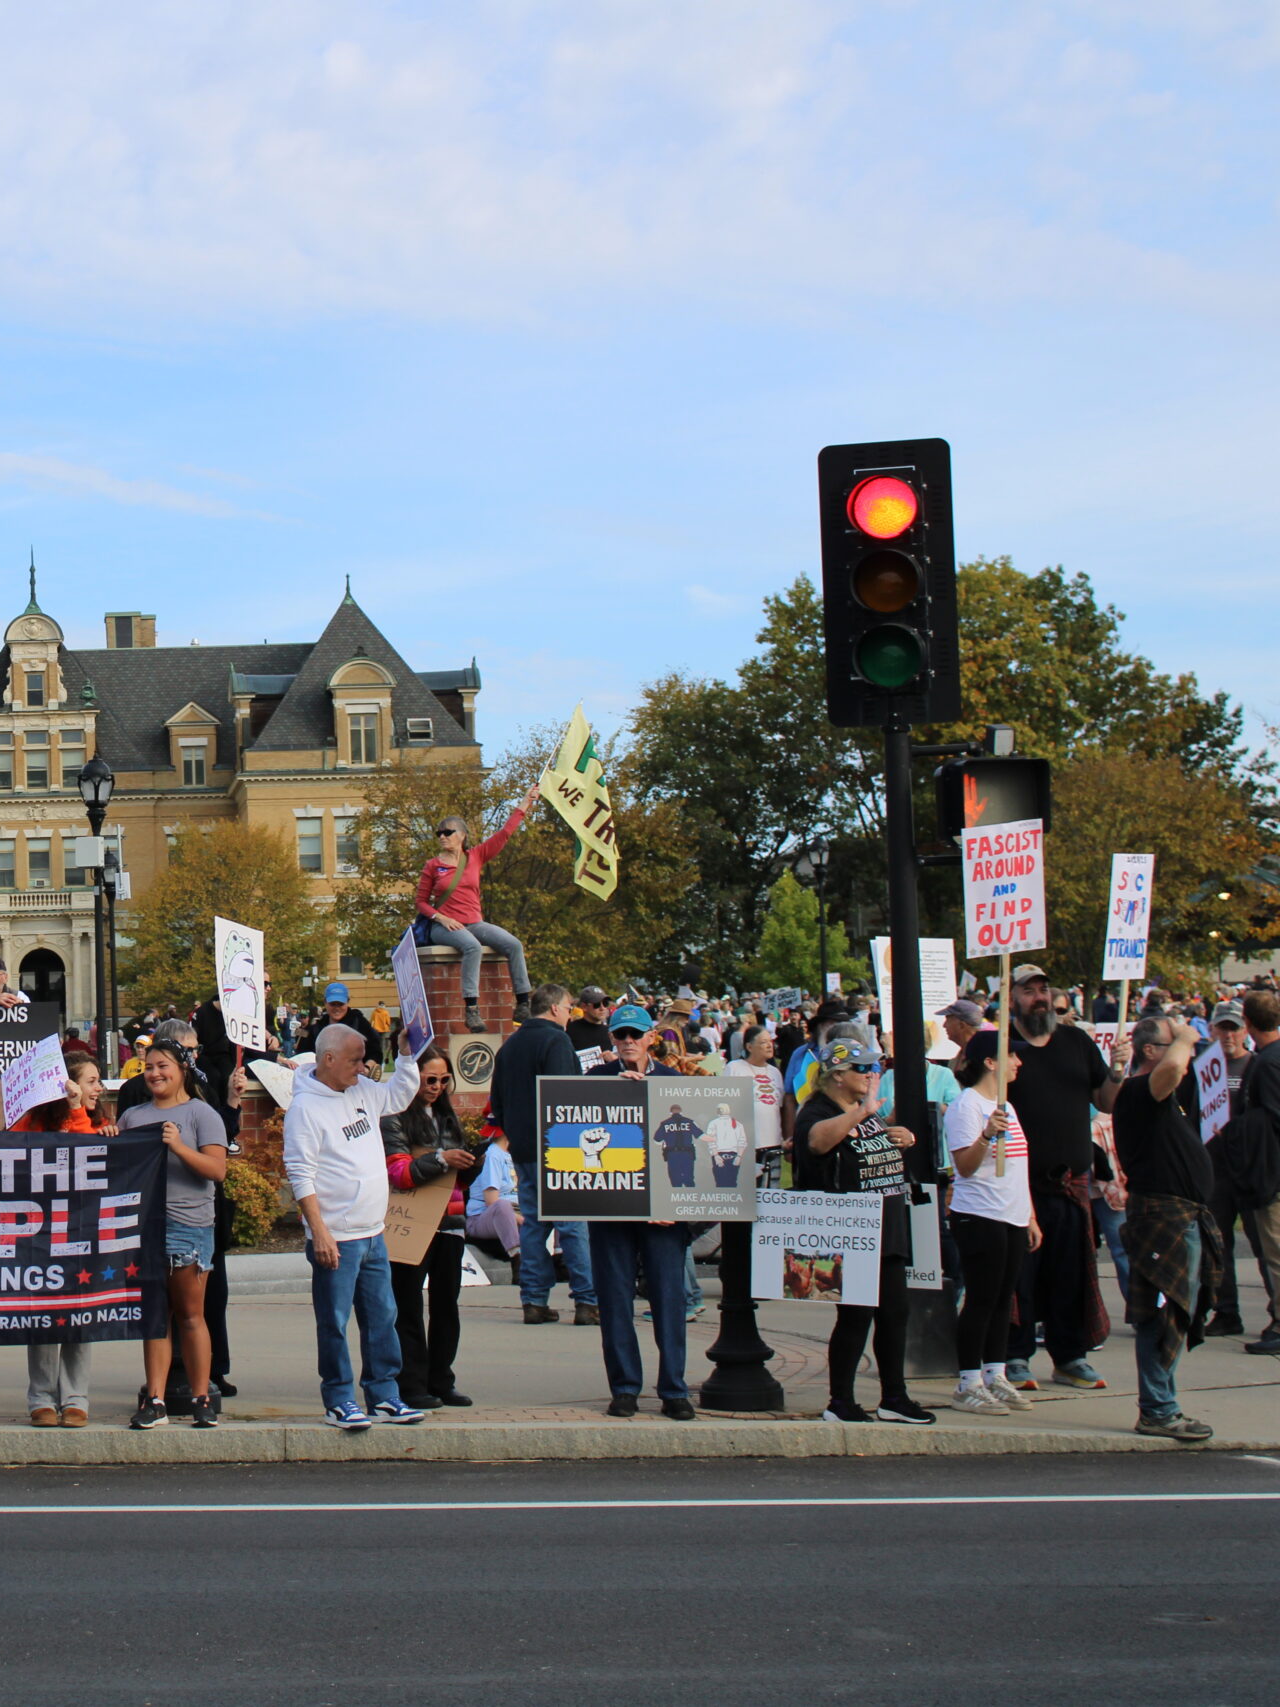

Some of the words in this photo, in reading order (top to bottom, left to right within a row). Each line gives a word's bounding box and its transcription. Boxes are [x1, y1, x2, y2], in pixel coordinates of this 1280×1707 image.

[558, 778, 584, 807] WE
[966, 829, 1041, 860] FASCIST
[972, 855, 1035, 882] AROUND
[993, 883, 1016, 897] AND
[976, 898, 1032, 922] FIND
[978, 918, 1031, 946] OUT
[39, 1065, 62, 1082] THE
[1200, 1057, 1221, 1092] NO
[5, 1075, 21, 1096] NOT
[659, 1088, 663, 1097] I
[664, 1087, 692, 1097] HAVE
[694, 1088, 702, 1097] A
[704, 1087, 741, 1097] DREAM
[546, 1106, 551, 1123] I
[555, 1105, 602, 1123] STAND
[606, 1105, 644, 1123] WITH
[342, 1117, 371, 1141] PUMA
[546, 1172, 646, 1191] UKRAINE
[671, 1193, 697, 1203] MAKE
[700, 1193, 743, 1203] AMERICA
[790, 1196, 807, 1205] are
[810, 1197, 823, 1206] so
[825, 1196, 880, 1209] expensive
[675, 1206, 705, 1216] GREAT
[707, 1206, 738, 1216] AGAIN
[794, 1215, 806, 1225] all
[808, 1216, 824, 1226] the
[825, 1216, 880, 1229] CHICKENS
[759, 1235, 780, 1246] are
[783, 1233, 795, 1246] in
[798, 1233, 876, 1251] CONGRESS
[71, 1312, 92, 1326] NO
[97, 1306, 142, 1321] NAZIS
